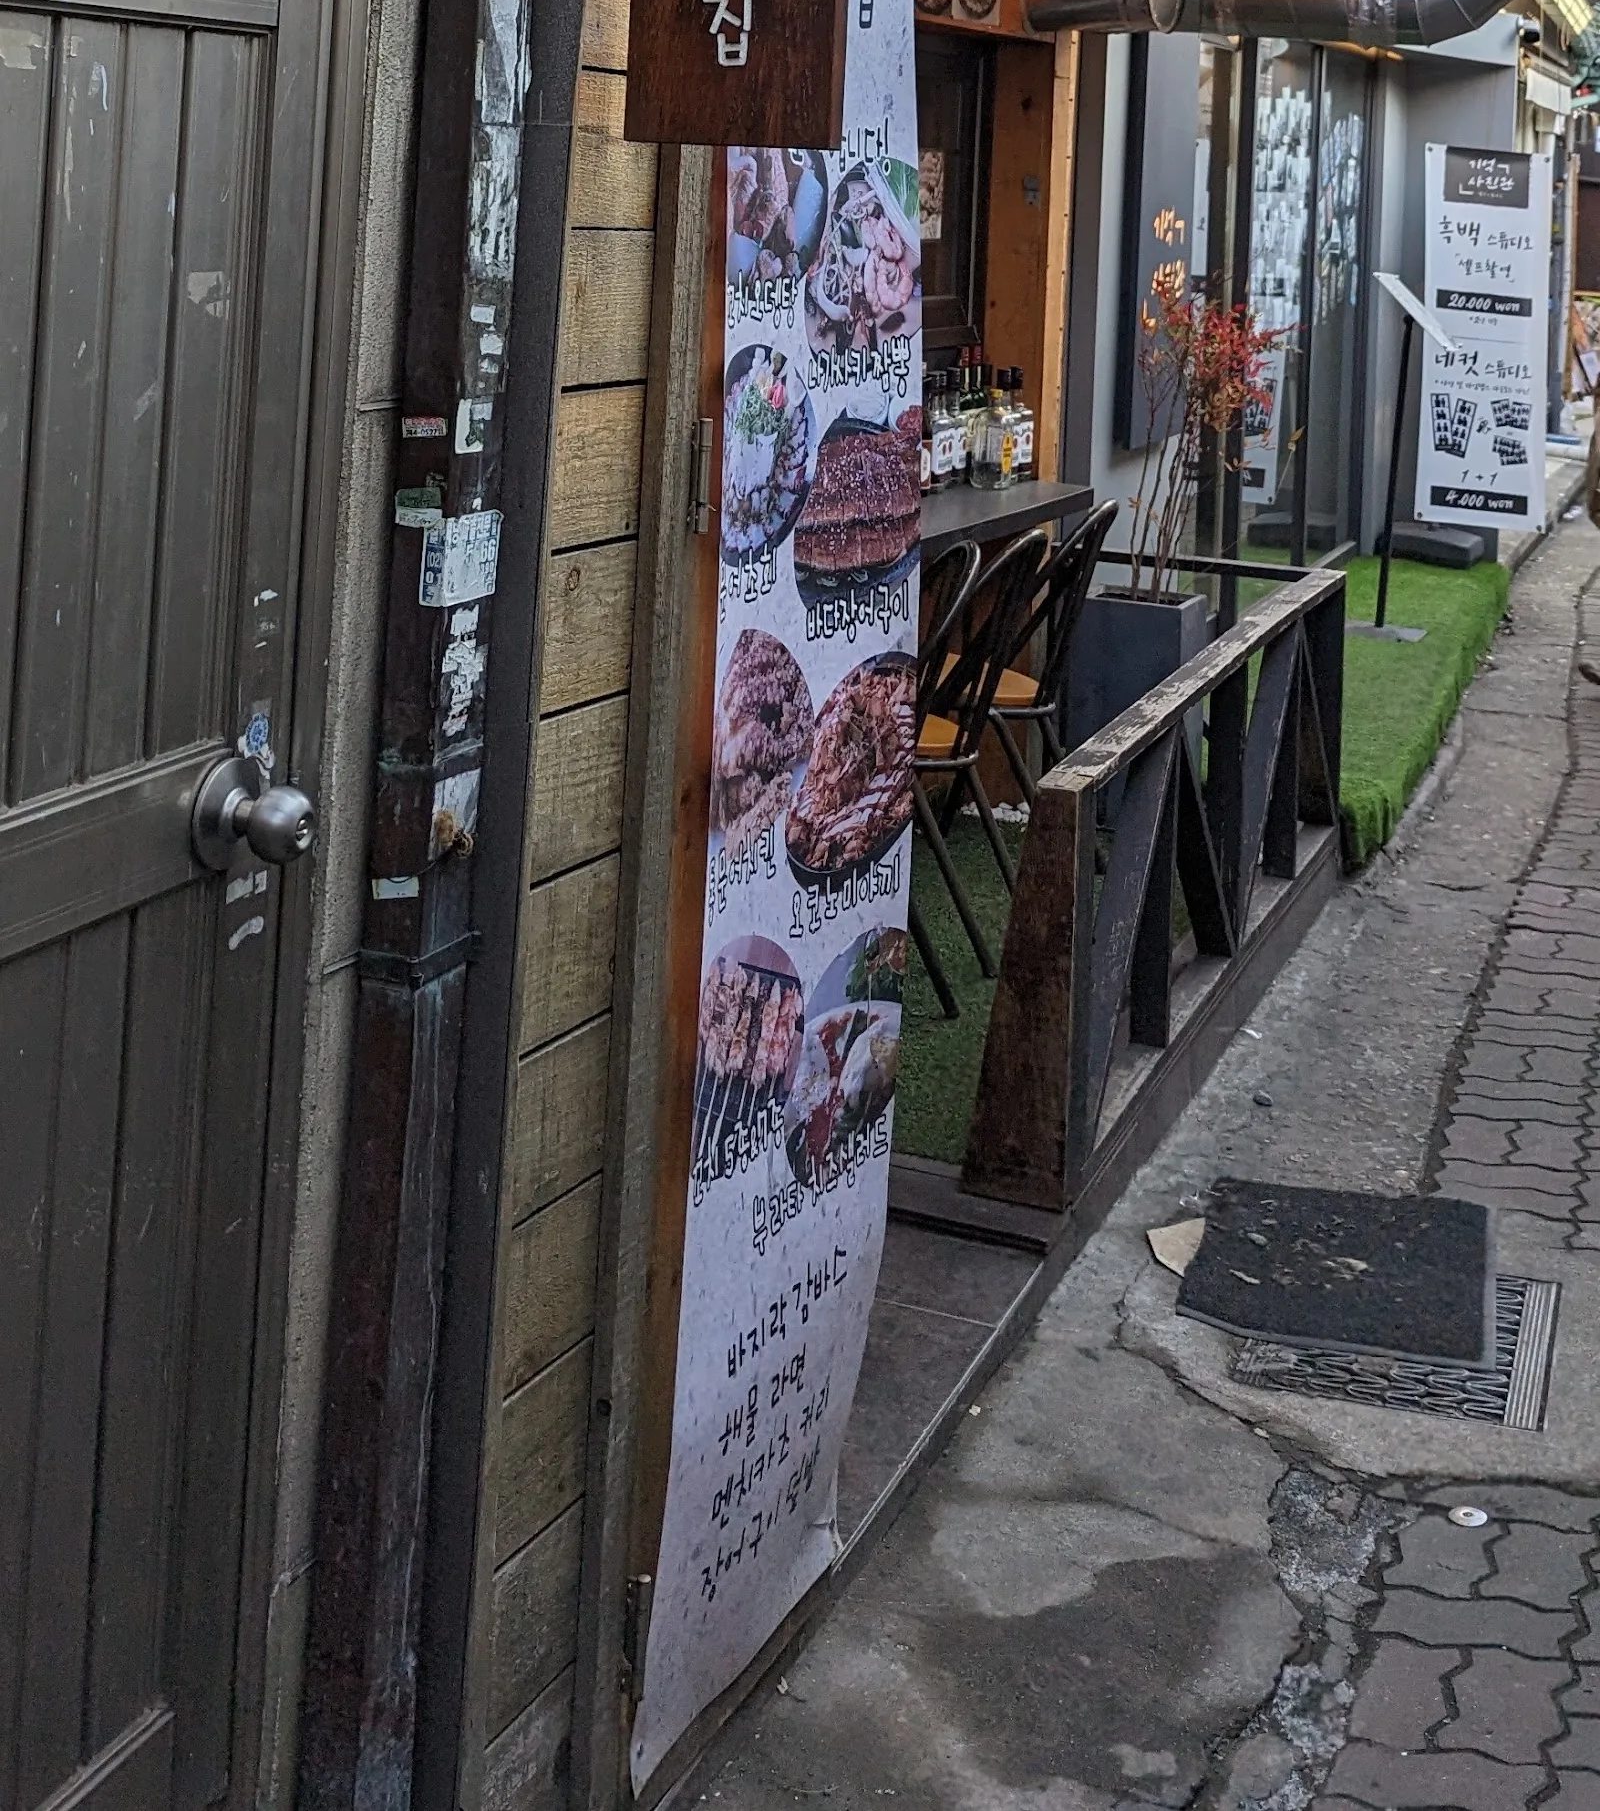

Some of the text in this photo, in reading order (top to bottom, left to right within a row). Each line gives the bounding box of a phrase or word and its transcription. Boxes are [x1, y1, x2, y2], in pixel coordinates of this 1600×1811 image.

[1438, 215, 1533, 251] 흑백 스튜디오
[1494, 301, 1520, 312] won
[1435, 350, 1533, 380] 네컷 스튜디오
[1488, 498, 1515, 510] won
[805, 578, 908, 644] 바다장어구이
[789, 853, 900, 939] 오코노미야끼
